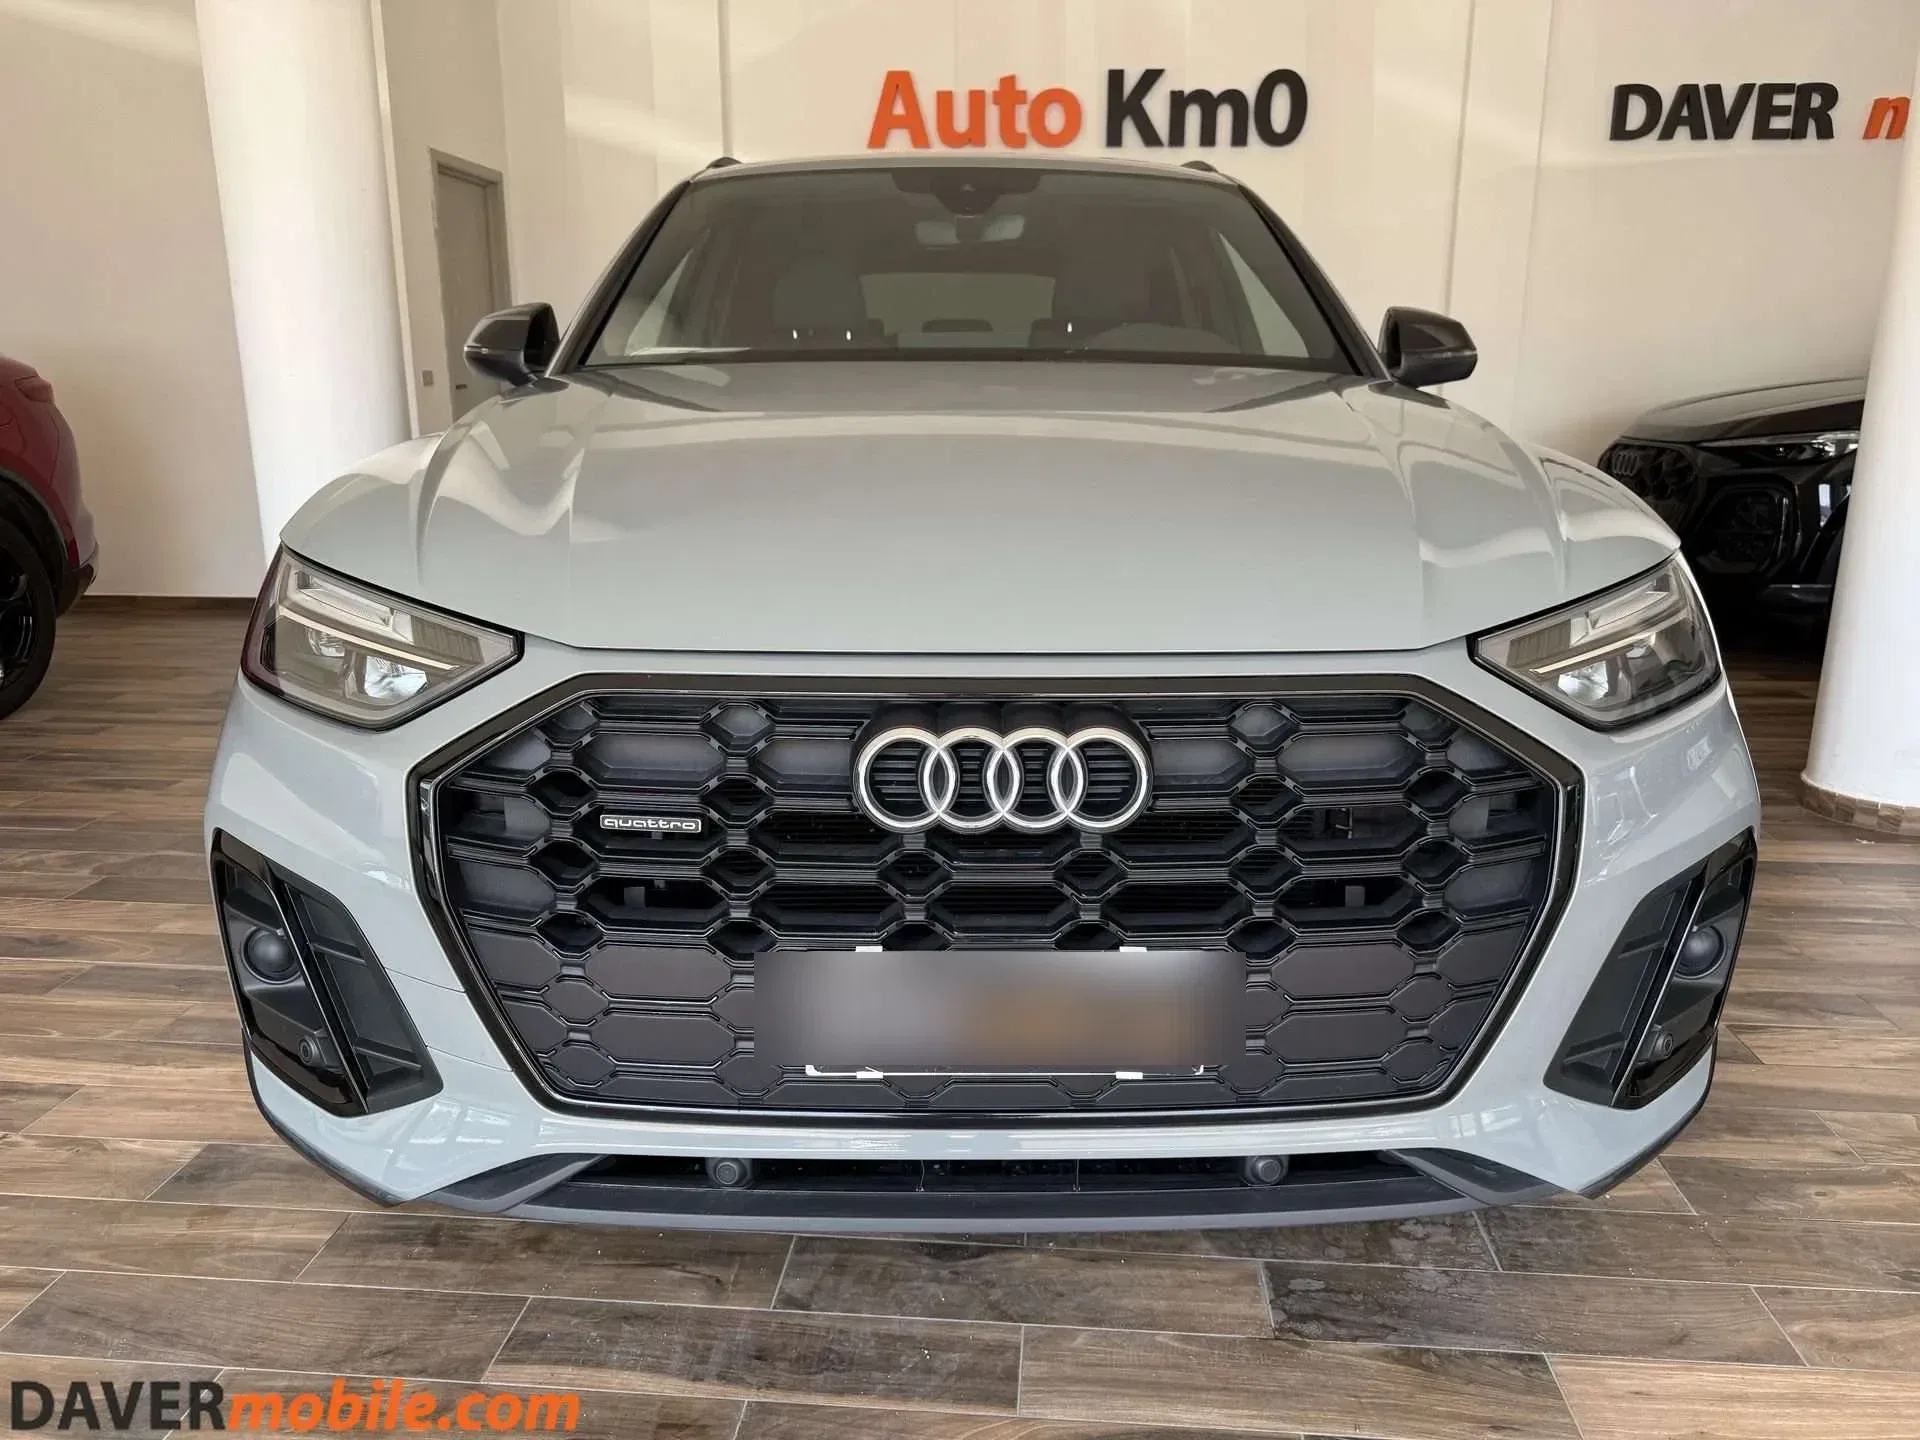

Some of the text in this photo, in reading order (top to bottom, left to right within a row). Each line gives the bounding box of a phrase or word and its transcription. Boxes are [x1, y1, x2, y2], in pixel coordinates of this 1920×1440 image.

[867, 68, 1308, 148] Auto Km0
[1609, 82, 1840, 140] DAVER
[603, 817, 697, 831] quattro
